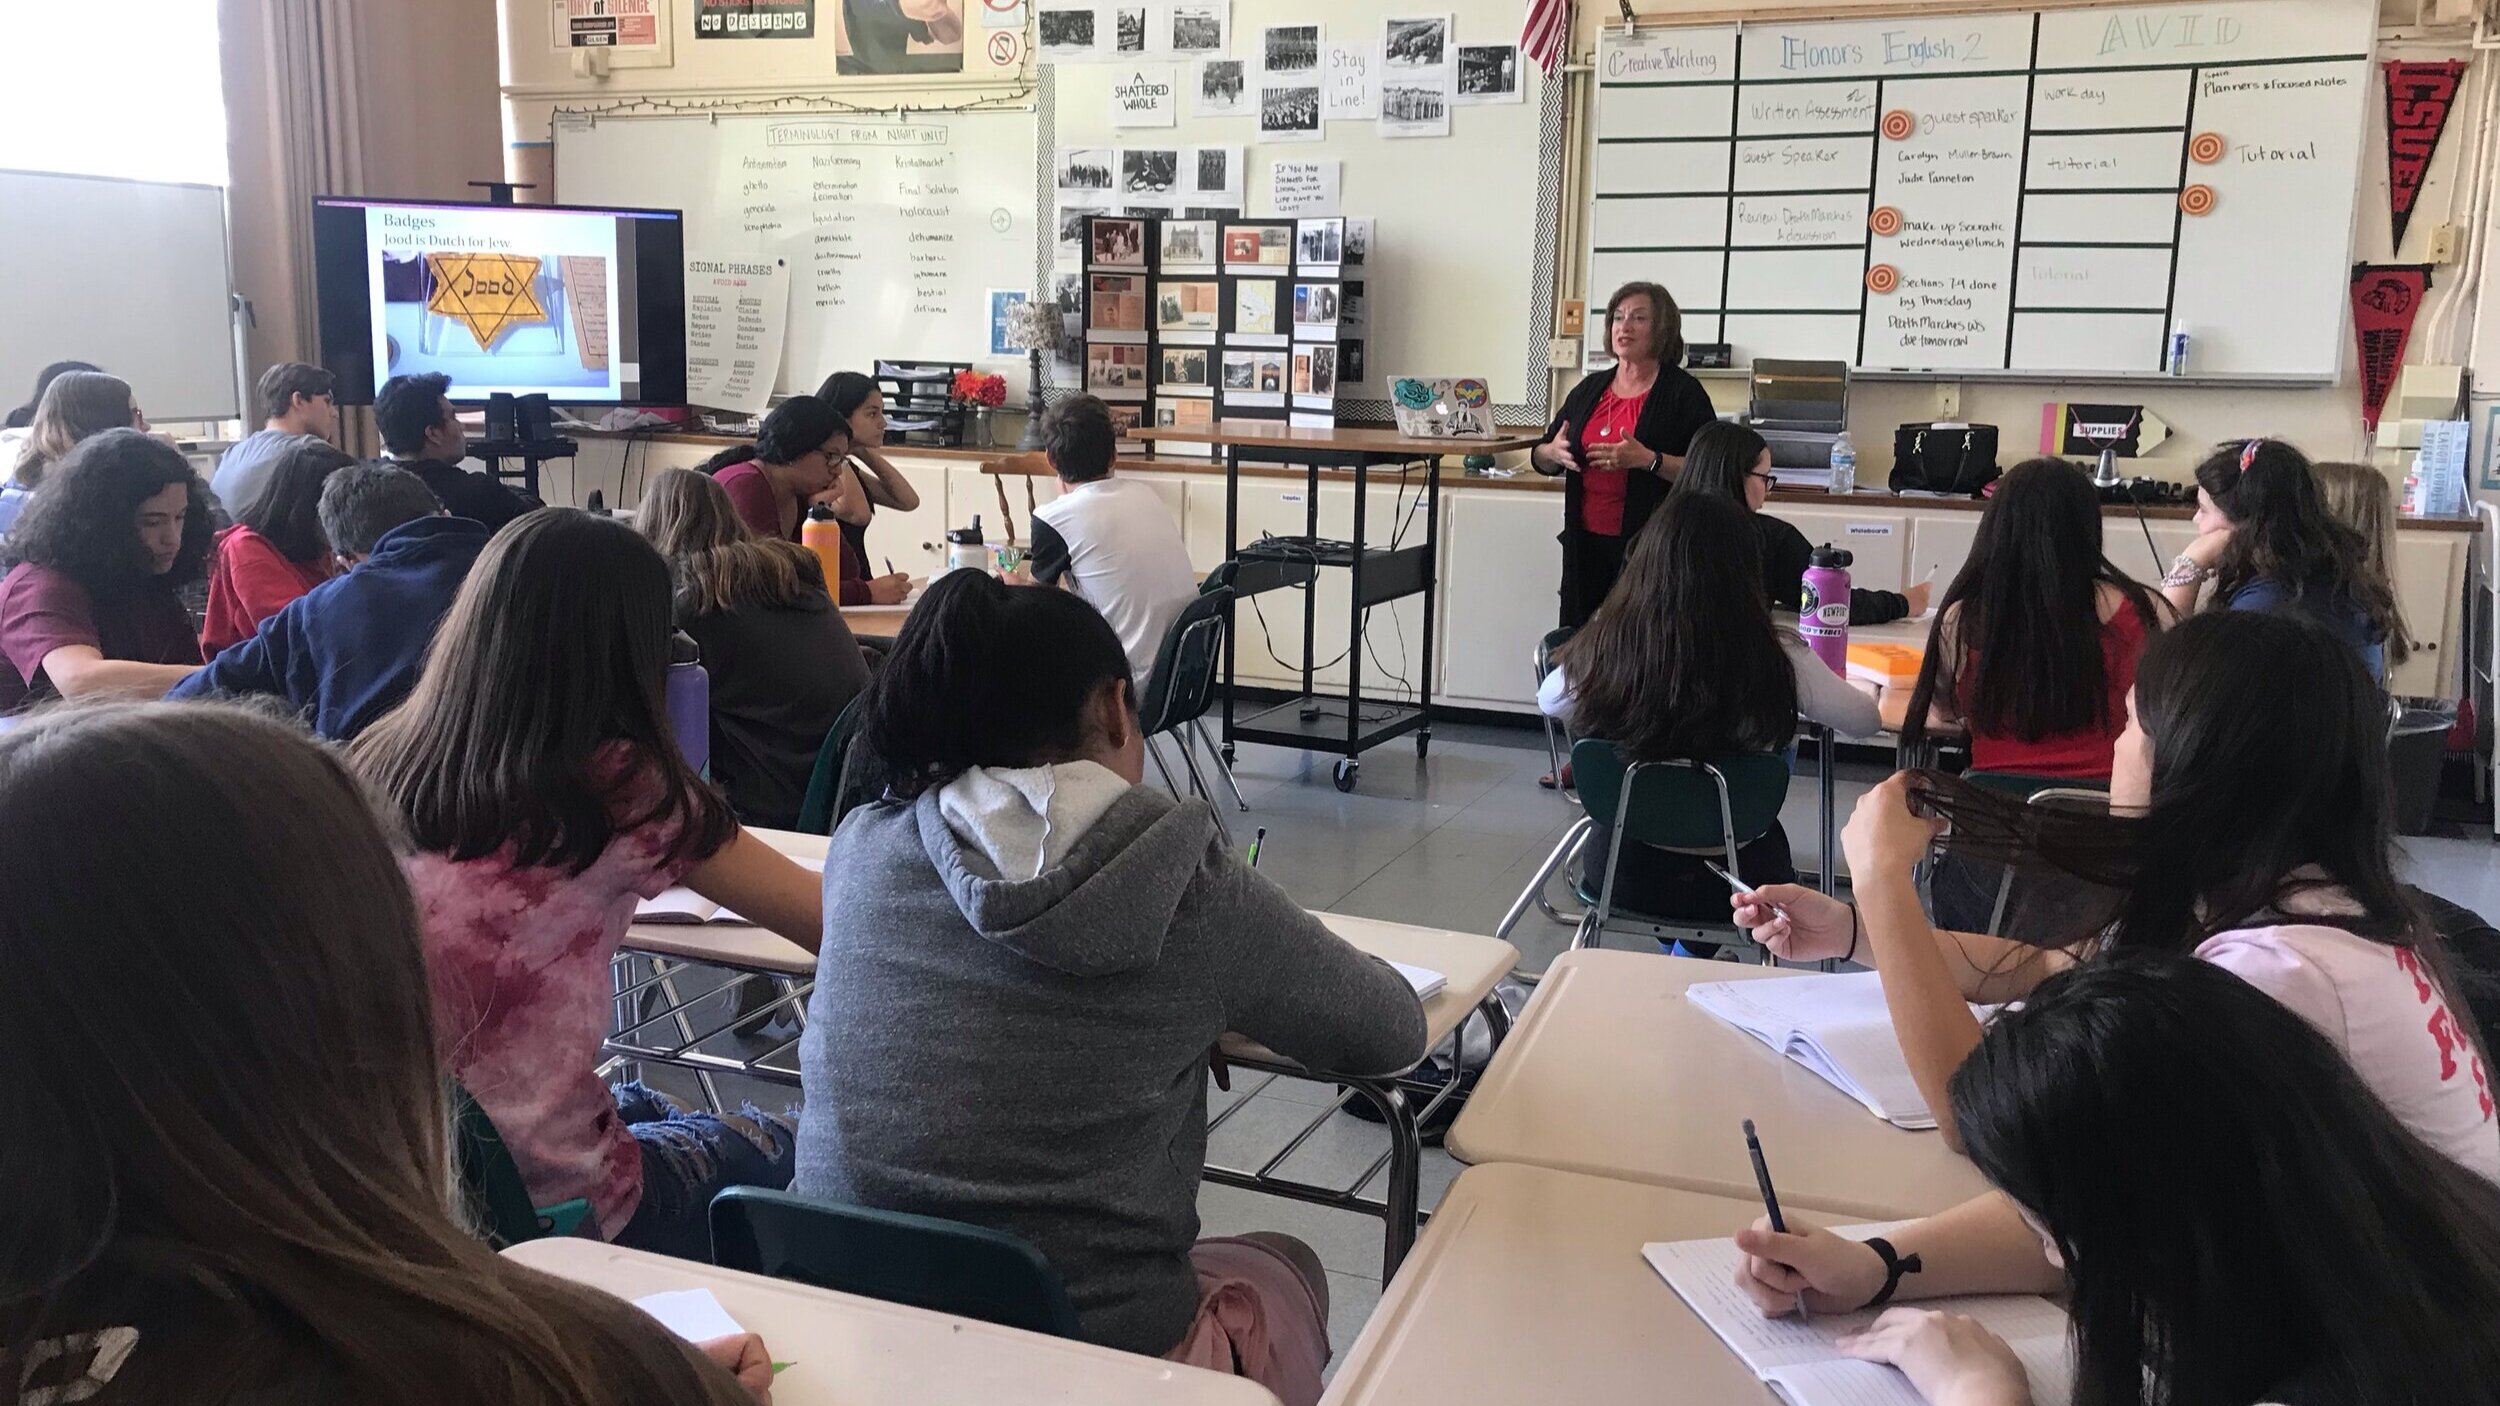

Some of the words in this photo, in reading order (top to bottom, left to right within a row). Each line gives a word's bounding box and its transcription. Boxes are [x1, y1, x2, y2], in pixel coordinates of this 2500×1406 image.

[594, 0, 604, 14] of
[608, 0, 650, 14] SILENCE
[728, 16, 806, 28] DISSING
[2097, 15, 2241, 55] AVID
[1781, 35, 1863, 71] Honors
[1882, 31, 1955, 68] English
[1962, 34, 1988, 62] 2
[1332, 50, 1366, 76] Stay
[1608, 50, 1663, 77] Creative
[1660, 46, 1716, 76] Writing
[1134, 72, 1144, 84] A
[1340, 76, 1354, 86] in
[1115, 84, 1169, 98] SHATTERED
[1330, 85, 1366, 108] Line!
[2204, 82, 2260, 98] Planners
[1123, 98, 1158, 111] WHOLE
[1752, 103, 1800, 120] Written
[1805, 100, 1876, 120] Assessment
[1922, 110, 1968, 135] guest
[770, 128, 840, 143] TERMINOLOGY
[851, 129, 878, 140] FROM
[887, 129, 916, 141] NIGHT
[920, 130, 944, 142] UNIT
[1743, 147, 1774, 164] Guest
[1782, 146, 1838, 165] Speaker
[2235, 142, 2316, 164] Tutorial
[900, 182, 921, 195] Final
[900, 206, 950, 218] holocaust
[384, 214, 436, 230] Badges
[1940, 224, 1956, 236] up
[384, 234, 412, 246] Jood
[416, 234, 426, 246] is
[430, 234, 464, 247] Dutch
[468, 236, 486, 248] for
[488, 236, 512, 250] Jew.
[690, 262, 726, 274] SIGNAL
[728, 264, 772, 276] PHRASES
[1970, 280, 1997, 290] done
[1900, 297, 1916, 310] by
[1920, 295, 1972, 310] Thursday
[2080, 426, 2123, 436] SUPPLIES
